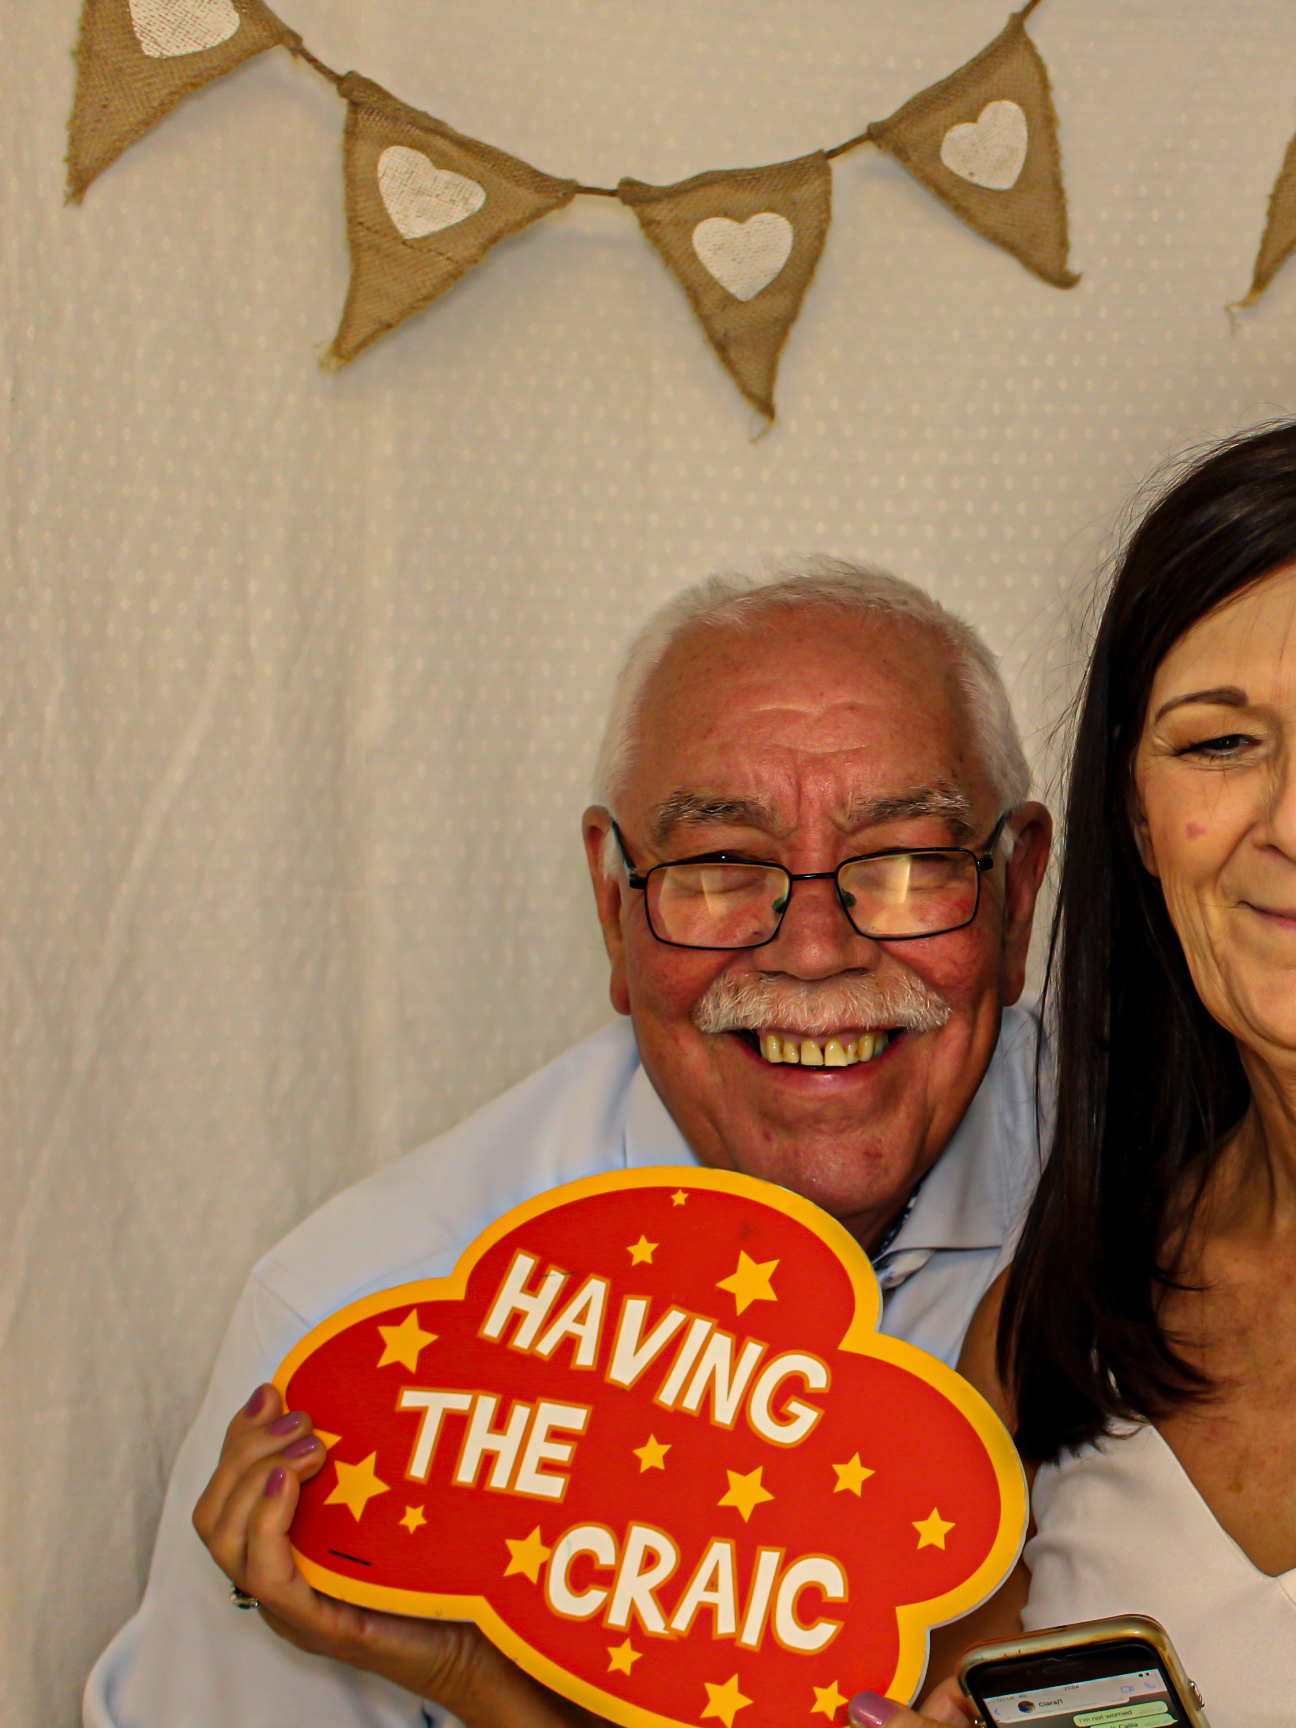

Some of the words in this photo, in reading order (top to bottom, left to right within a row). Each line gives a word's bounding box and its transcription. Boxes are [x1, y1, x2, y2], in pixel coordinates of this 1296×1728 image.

[481, 1252, 829, 1445] HAVING
[399, 1389, 589, 1499] THE
[547, 1524, 846, 1652] CRAIC
[1105, 1709, 1133, 1719] worried
